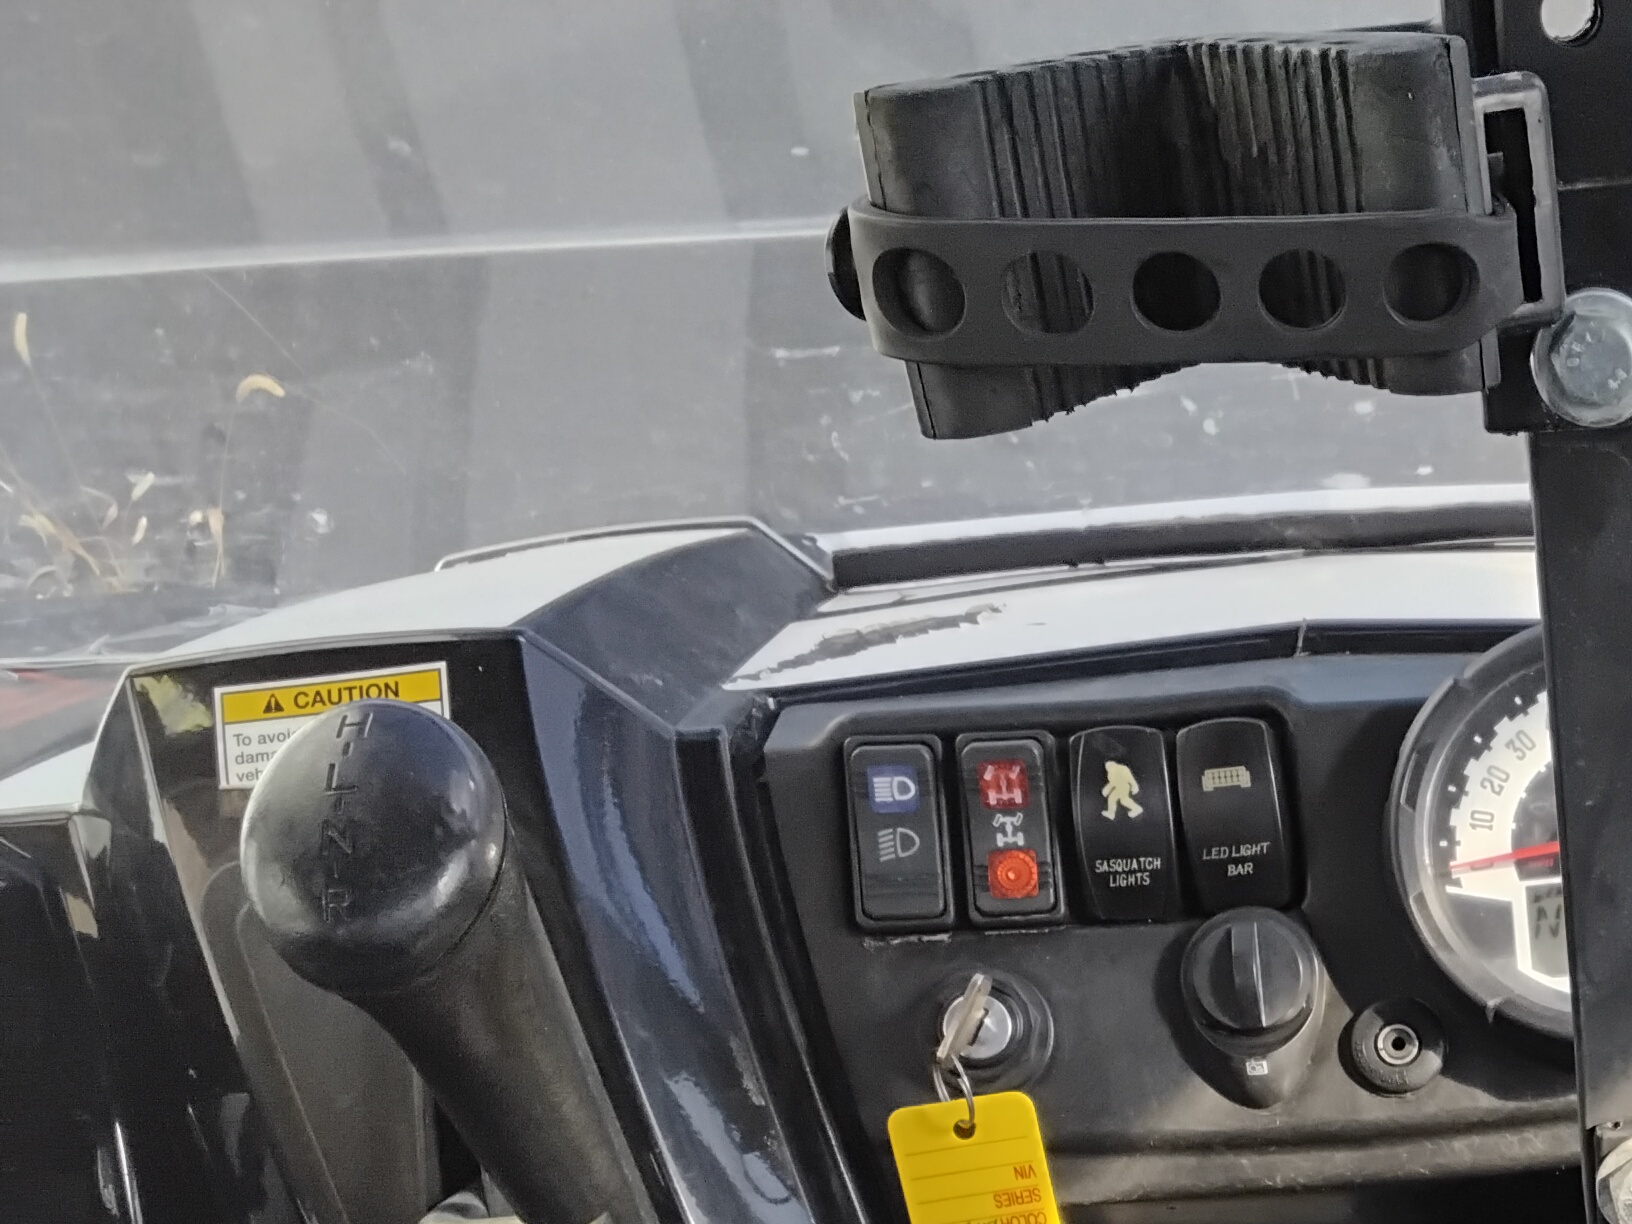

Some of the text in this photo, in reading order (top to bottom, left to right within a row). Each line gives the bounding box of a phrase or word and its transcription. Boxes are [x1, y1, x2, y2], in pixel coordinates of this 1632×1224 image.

[293, 680, 400, 709] CAUTION
[336, 712, 373, 738] H
[233, 733, 252, 747] To
[1505, 730, 1536, 761] 30
[324, 763, 358, 795] L
[1480, 765, 1510, 796] 20
[1469, 810, 1495, 831] 10
[1203, 842, 1271, 861] LED LIGHT
[1095, 857, 1161, 873] SASQUATCH
[1227, 862, 1253, 877] BAR
[1109, 872, 1150, 887] LIGHTS
[1013, 1164, 1037, 1181] VIN
[994, 1187, 1042, 1208] SERIES
